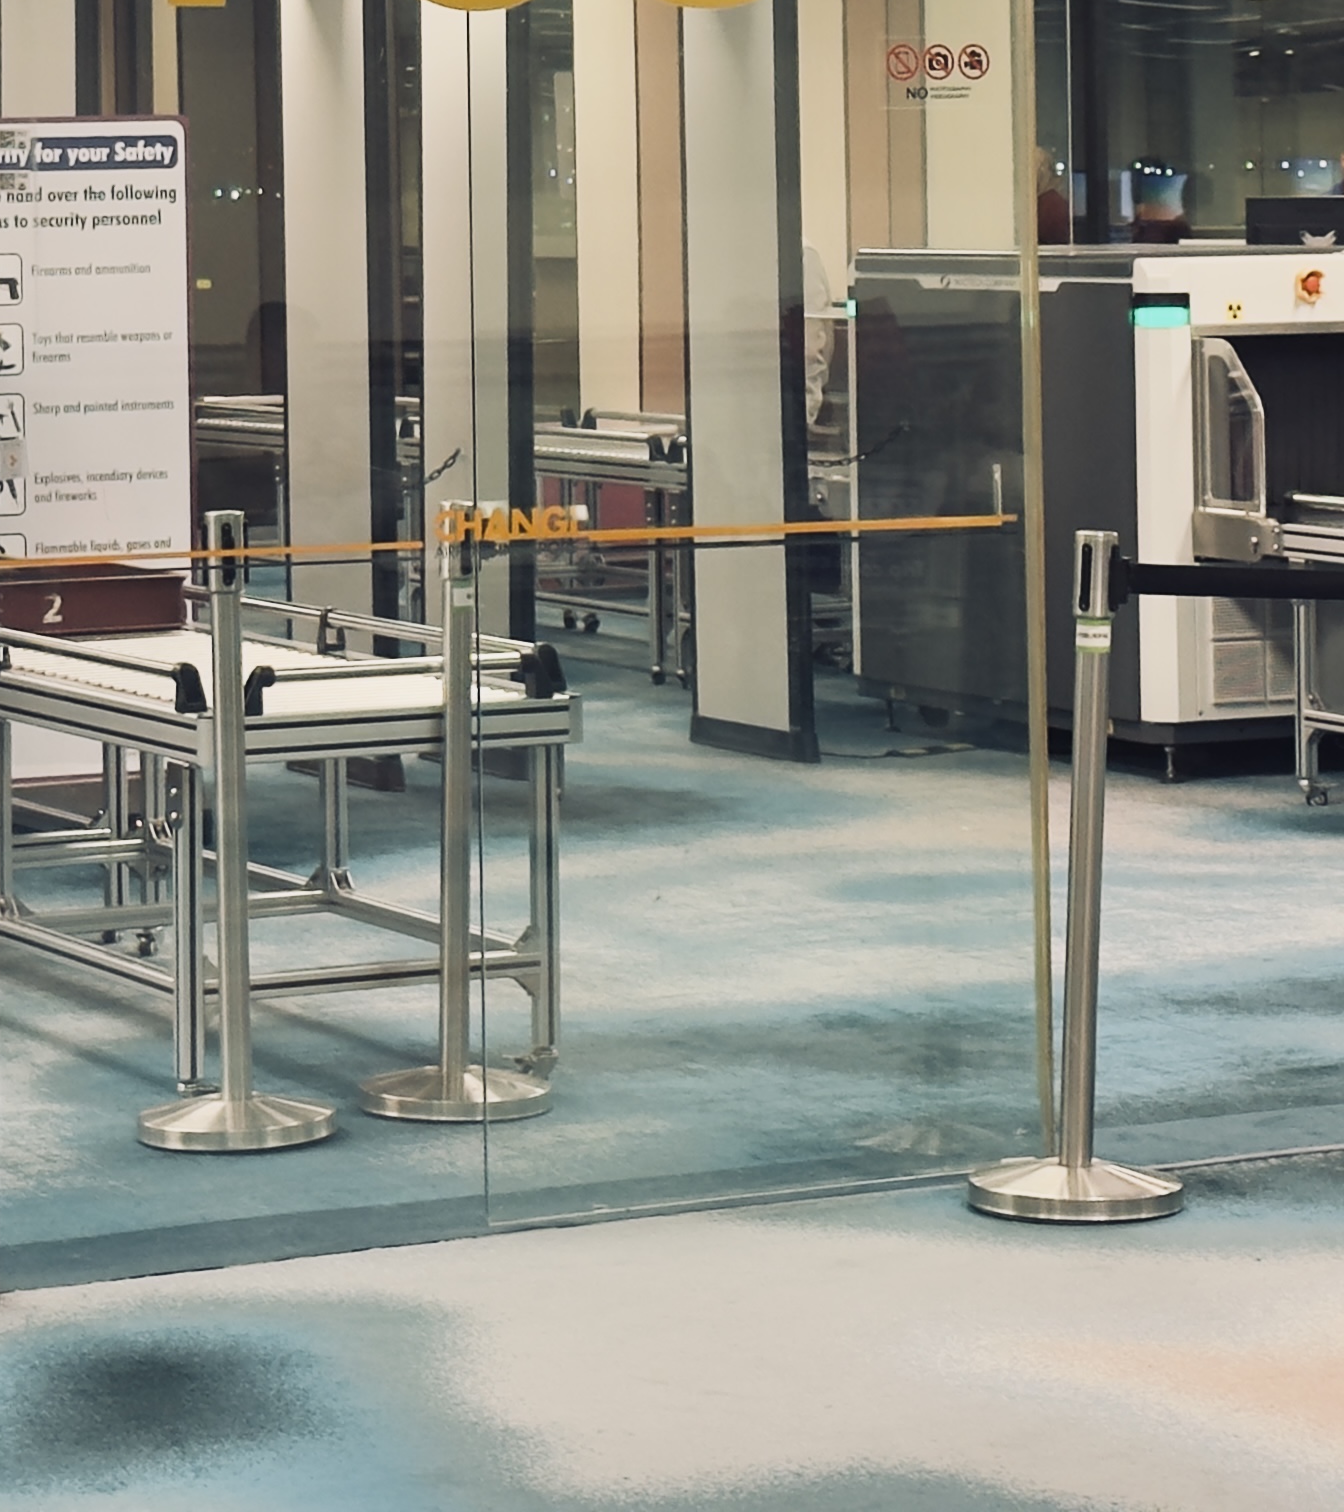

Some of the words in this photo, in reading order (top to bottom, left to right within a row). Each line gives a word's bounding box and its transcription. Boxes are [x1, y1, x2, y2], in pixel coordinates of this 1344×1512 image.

[906, 86, 928, 99] NO
[35, 141, 62, 163] for
[67, 147, 110, 167] your
[114, 140, 173, 165] Safety
[48, 191, 79, 202] over
[84, 185, 105, 201] the
[111, 184, 177, 204] following
[14, 215, 28, 228] to
[33, 212, 86, 230] security
[93, 209, 162, 230] personnel
[31, 265, 72, 276] Firearms
[75, 263, 92, 275] and
[95, 263, 151, 275] ammunition
[32, 333, 52, 347] Toys
[56, 332, 73, 343] that
[76, 331, 119, 343] resemble
[121, 332, 160, 343] weapons
[163, 331, 173, 341] or
[32, 351, 71, 363] firearms
[33, 402, 60, 416] Sharp
[63, 402, 81, 414] and
[84, 400, 119, 414] pointed
[121, 399, 174, 411] instruments
[87, 469, 133, 483] incendiary
[136, 468, 169, 480] devices
[35, 491, 52, 503] and
[55, 490, 97, 502] fireworks
[35, 541, 87, 554] Flammable
[126, 541, 151, 553] gases
[154, 537, 172, 549] and
[42, 593, 64, 624] 2
